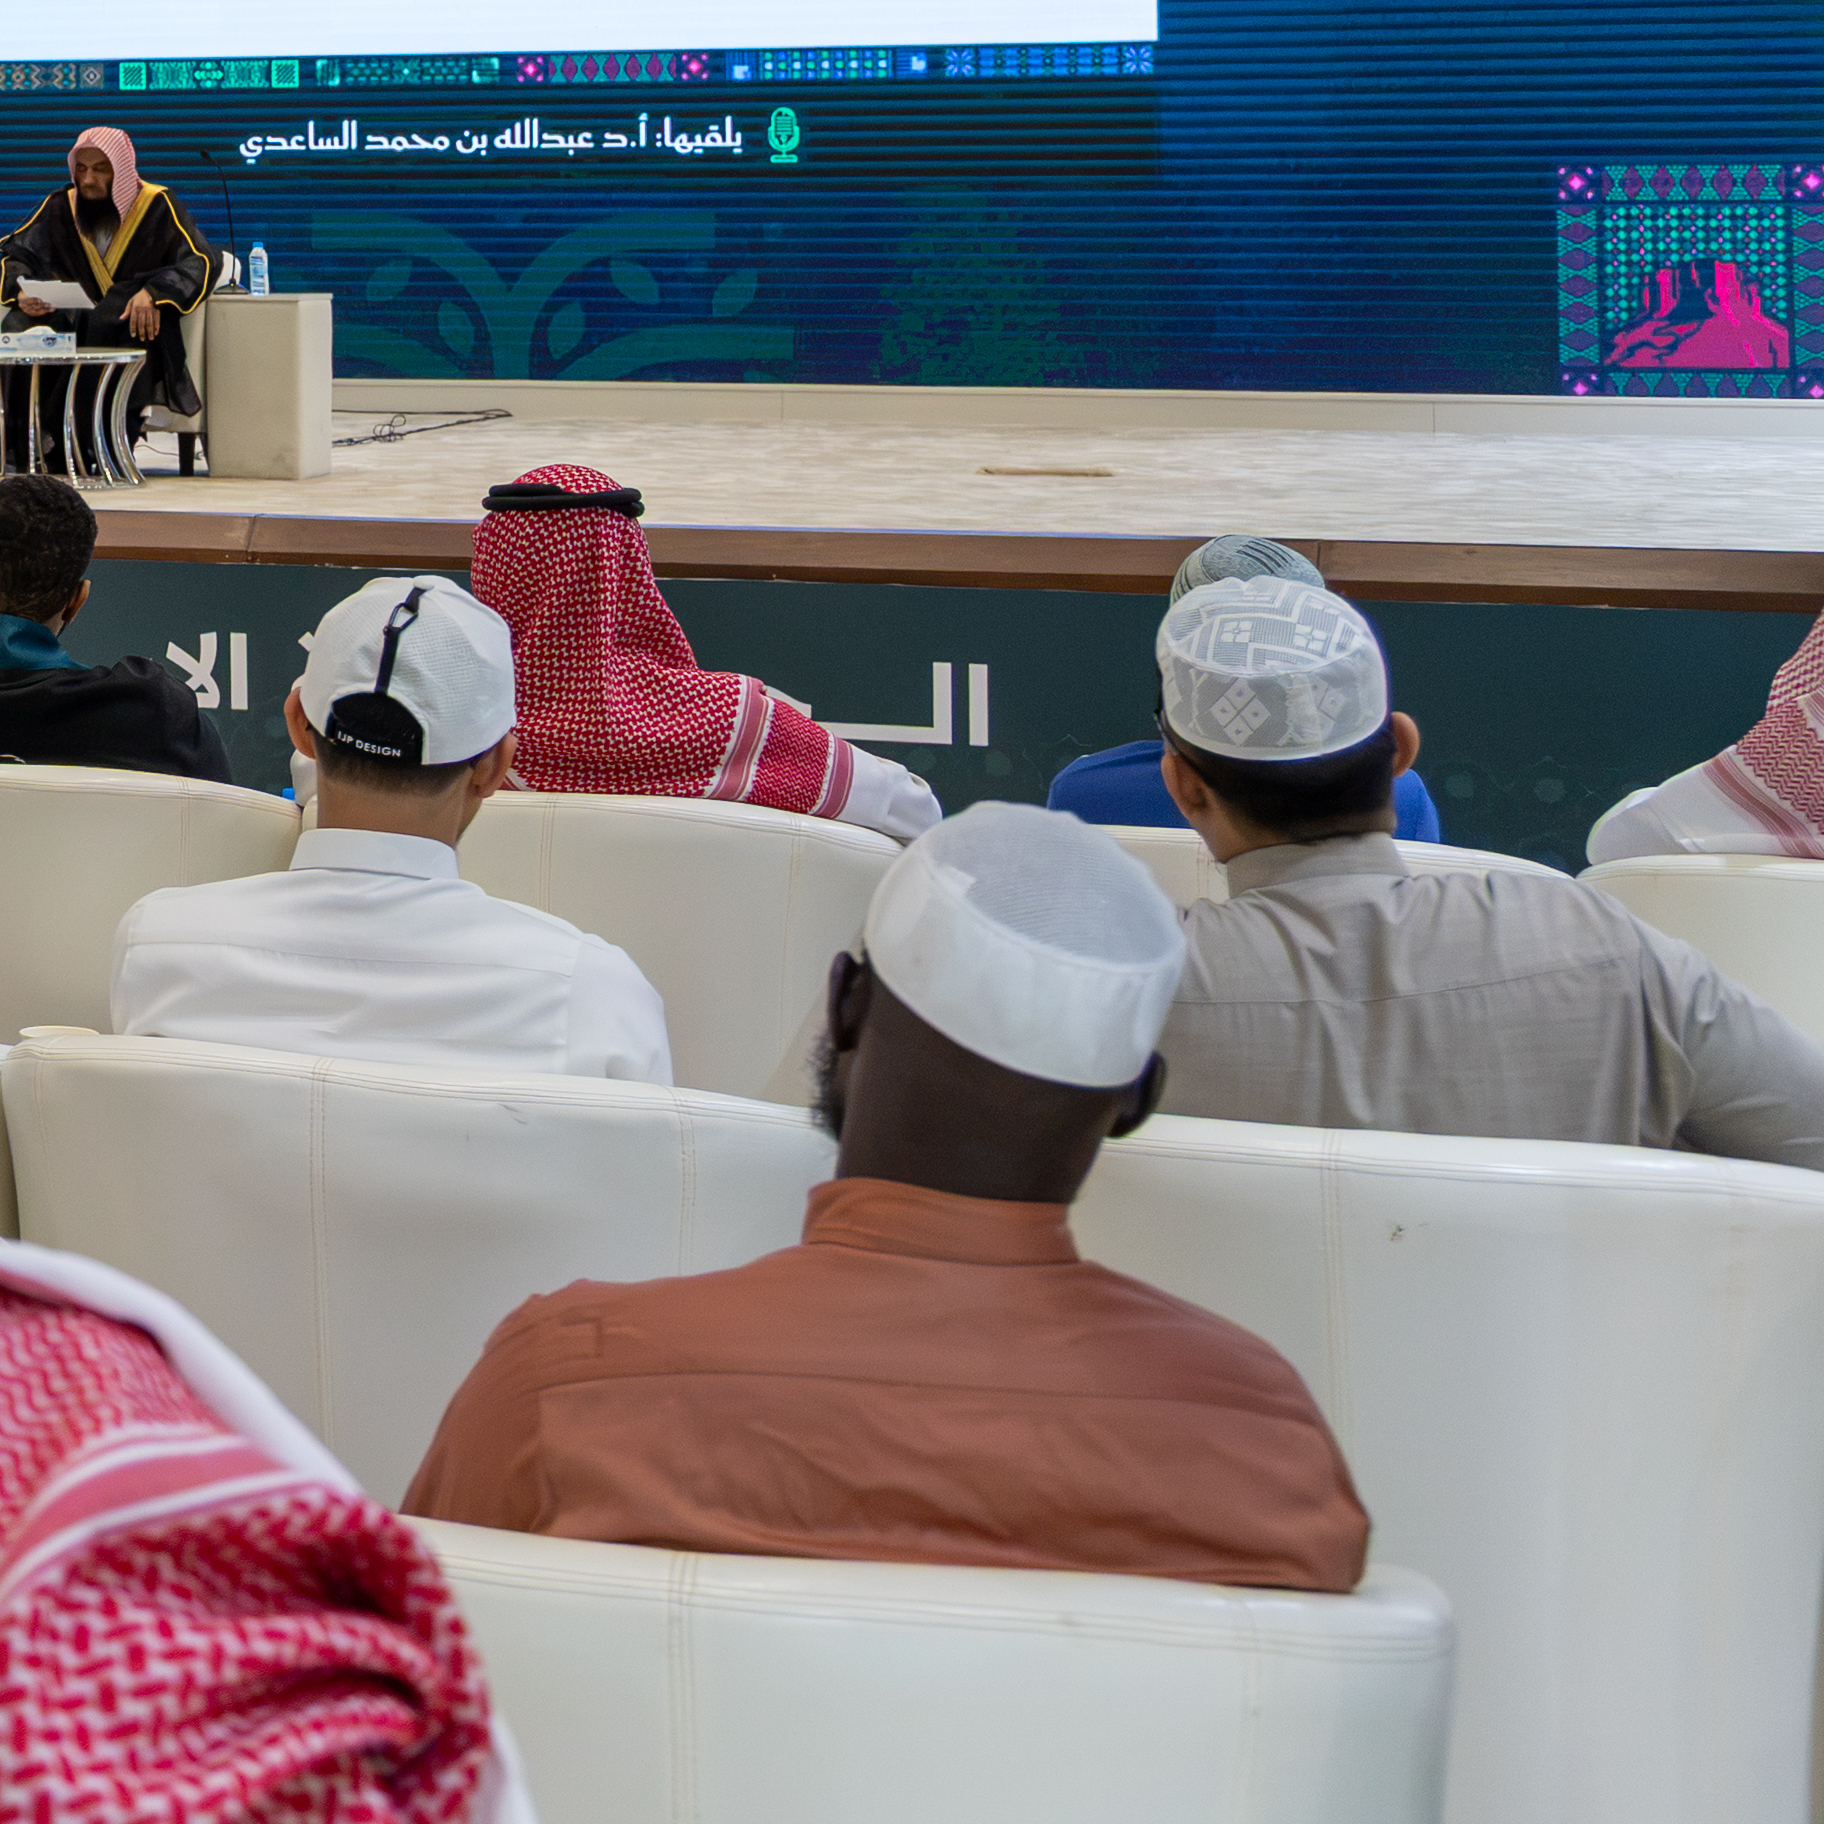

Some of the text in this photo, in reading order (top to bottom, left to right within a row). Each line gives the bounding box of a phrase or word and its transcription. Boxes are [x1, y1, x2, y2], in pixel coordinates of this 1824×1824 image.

[240, 121, 356, 163] الساعدي
[366, 134, 449, 150] محمد
[456, 131, 487, 155] بن
[494, 119, 593, 154] عبدالله
[656, 116, 741, 153] يلقيها:
[355, 739, 402, 758] DESIGN
